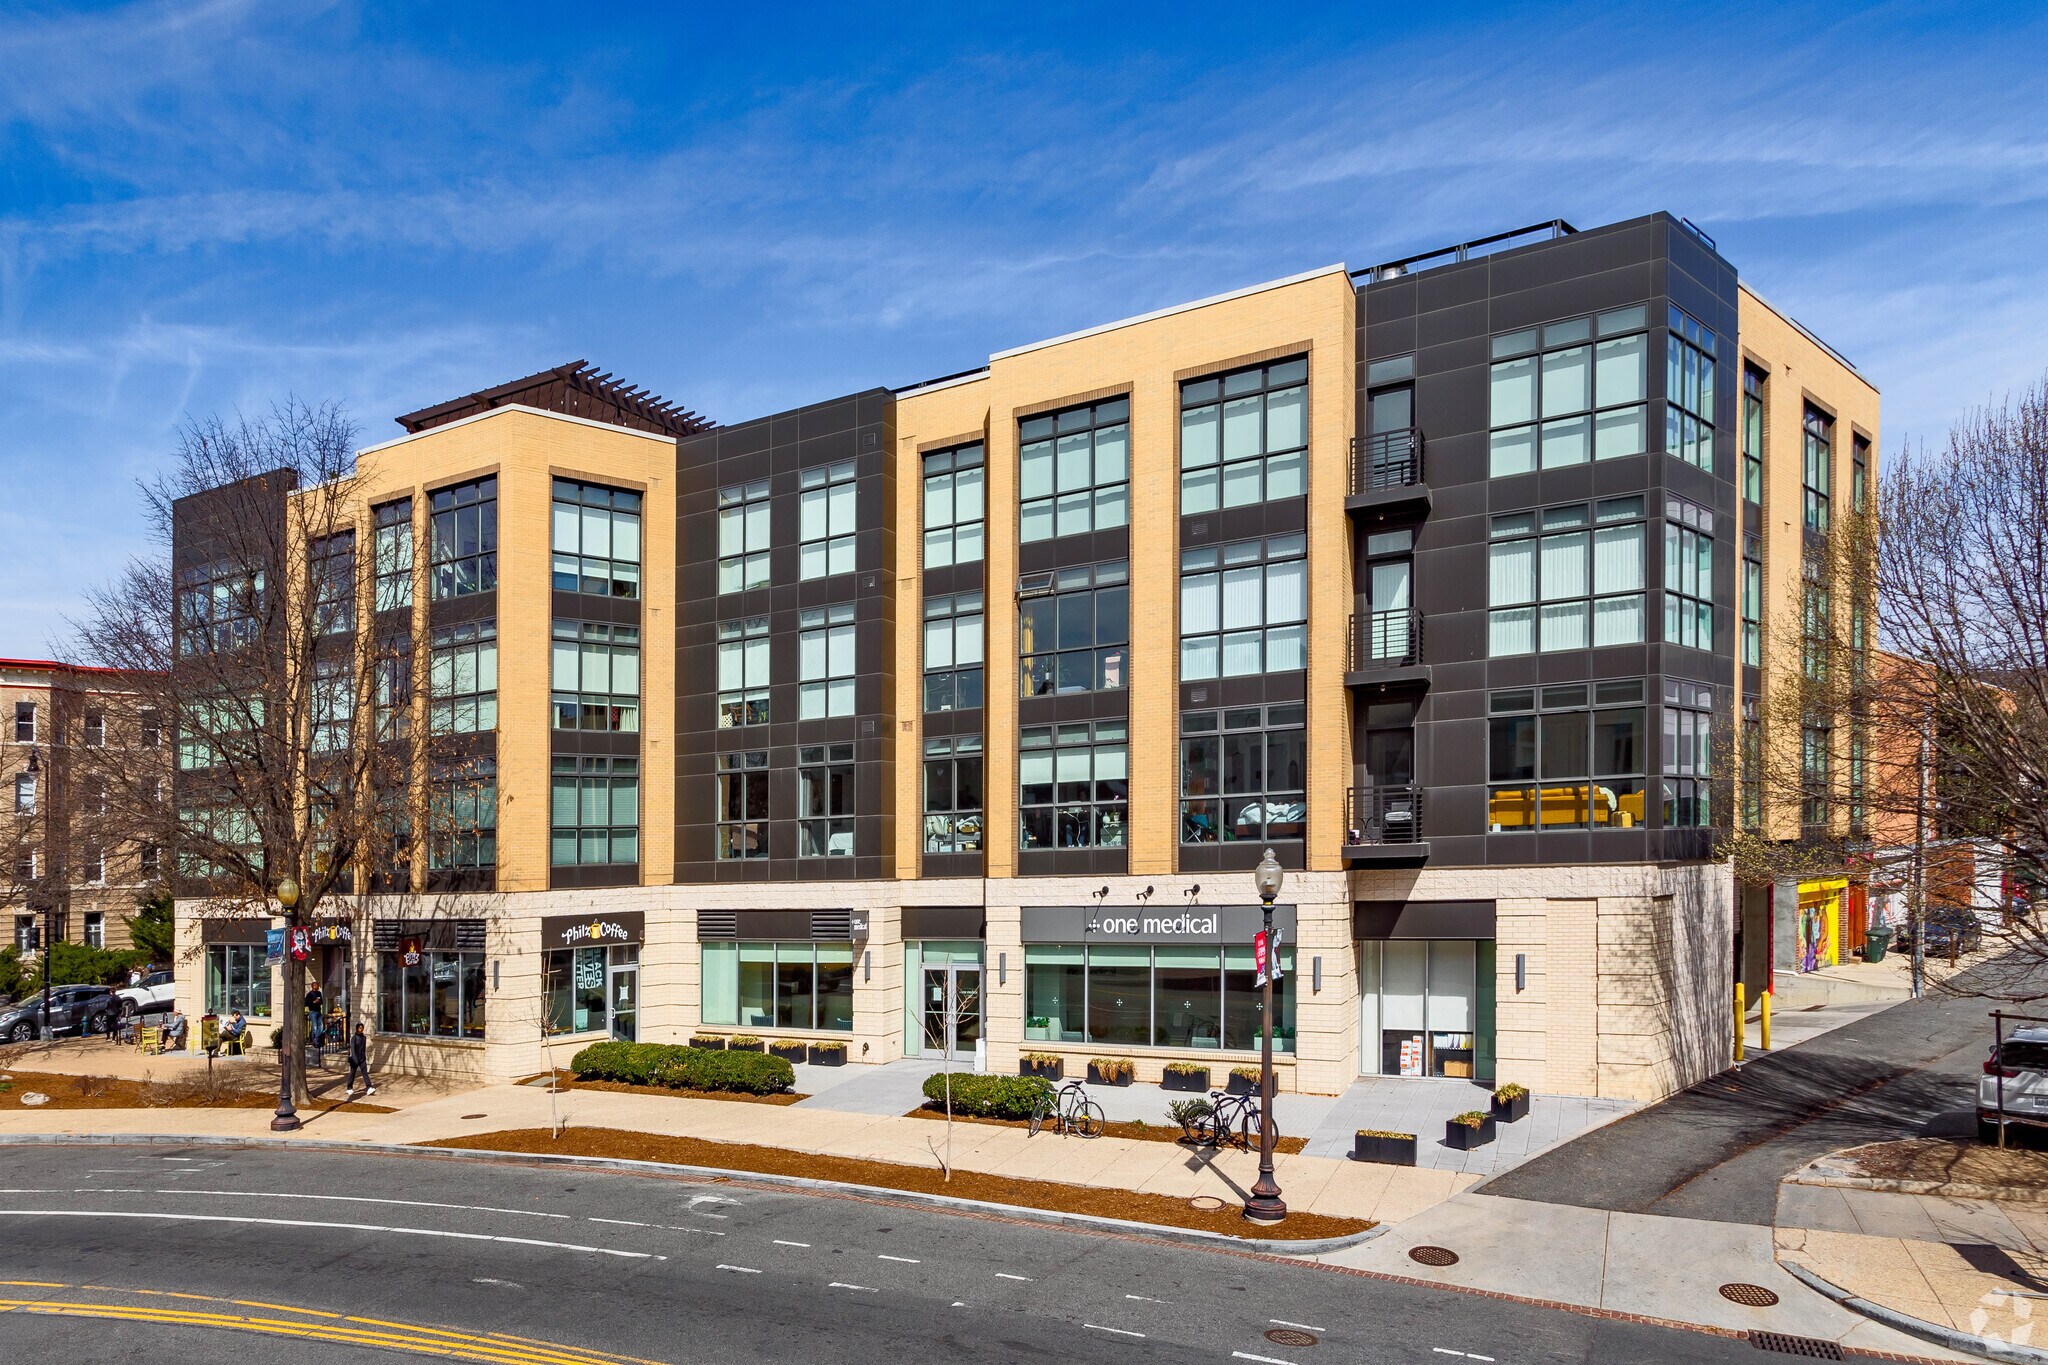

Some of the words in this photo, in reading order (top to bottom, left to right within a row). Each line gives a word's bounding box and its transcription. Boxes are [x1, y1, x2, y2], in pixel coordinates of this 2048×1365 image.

[312, 926, 330, 943] Philz
[561, 924, 591, 945] Philz
[600, 921, 628, 940] Coffee
[1103, 918, 1138, 934] one
[1144, 914, 1217, 934] medical
[585, 948, 595, 988] LIVES
